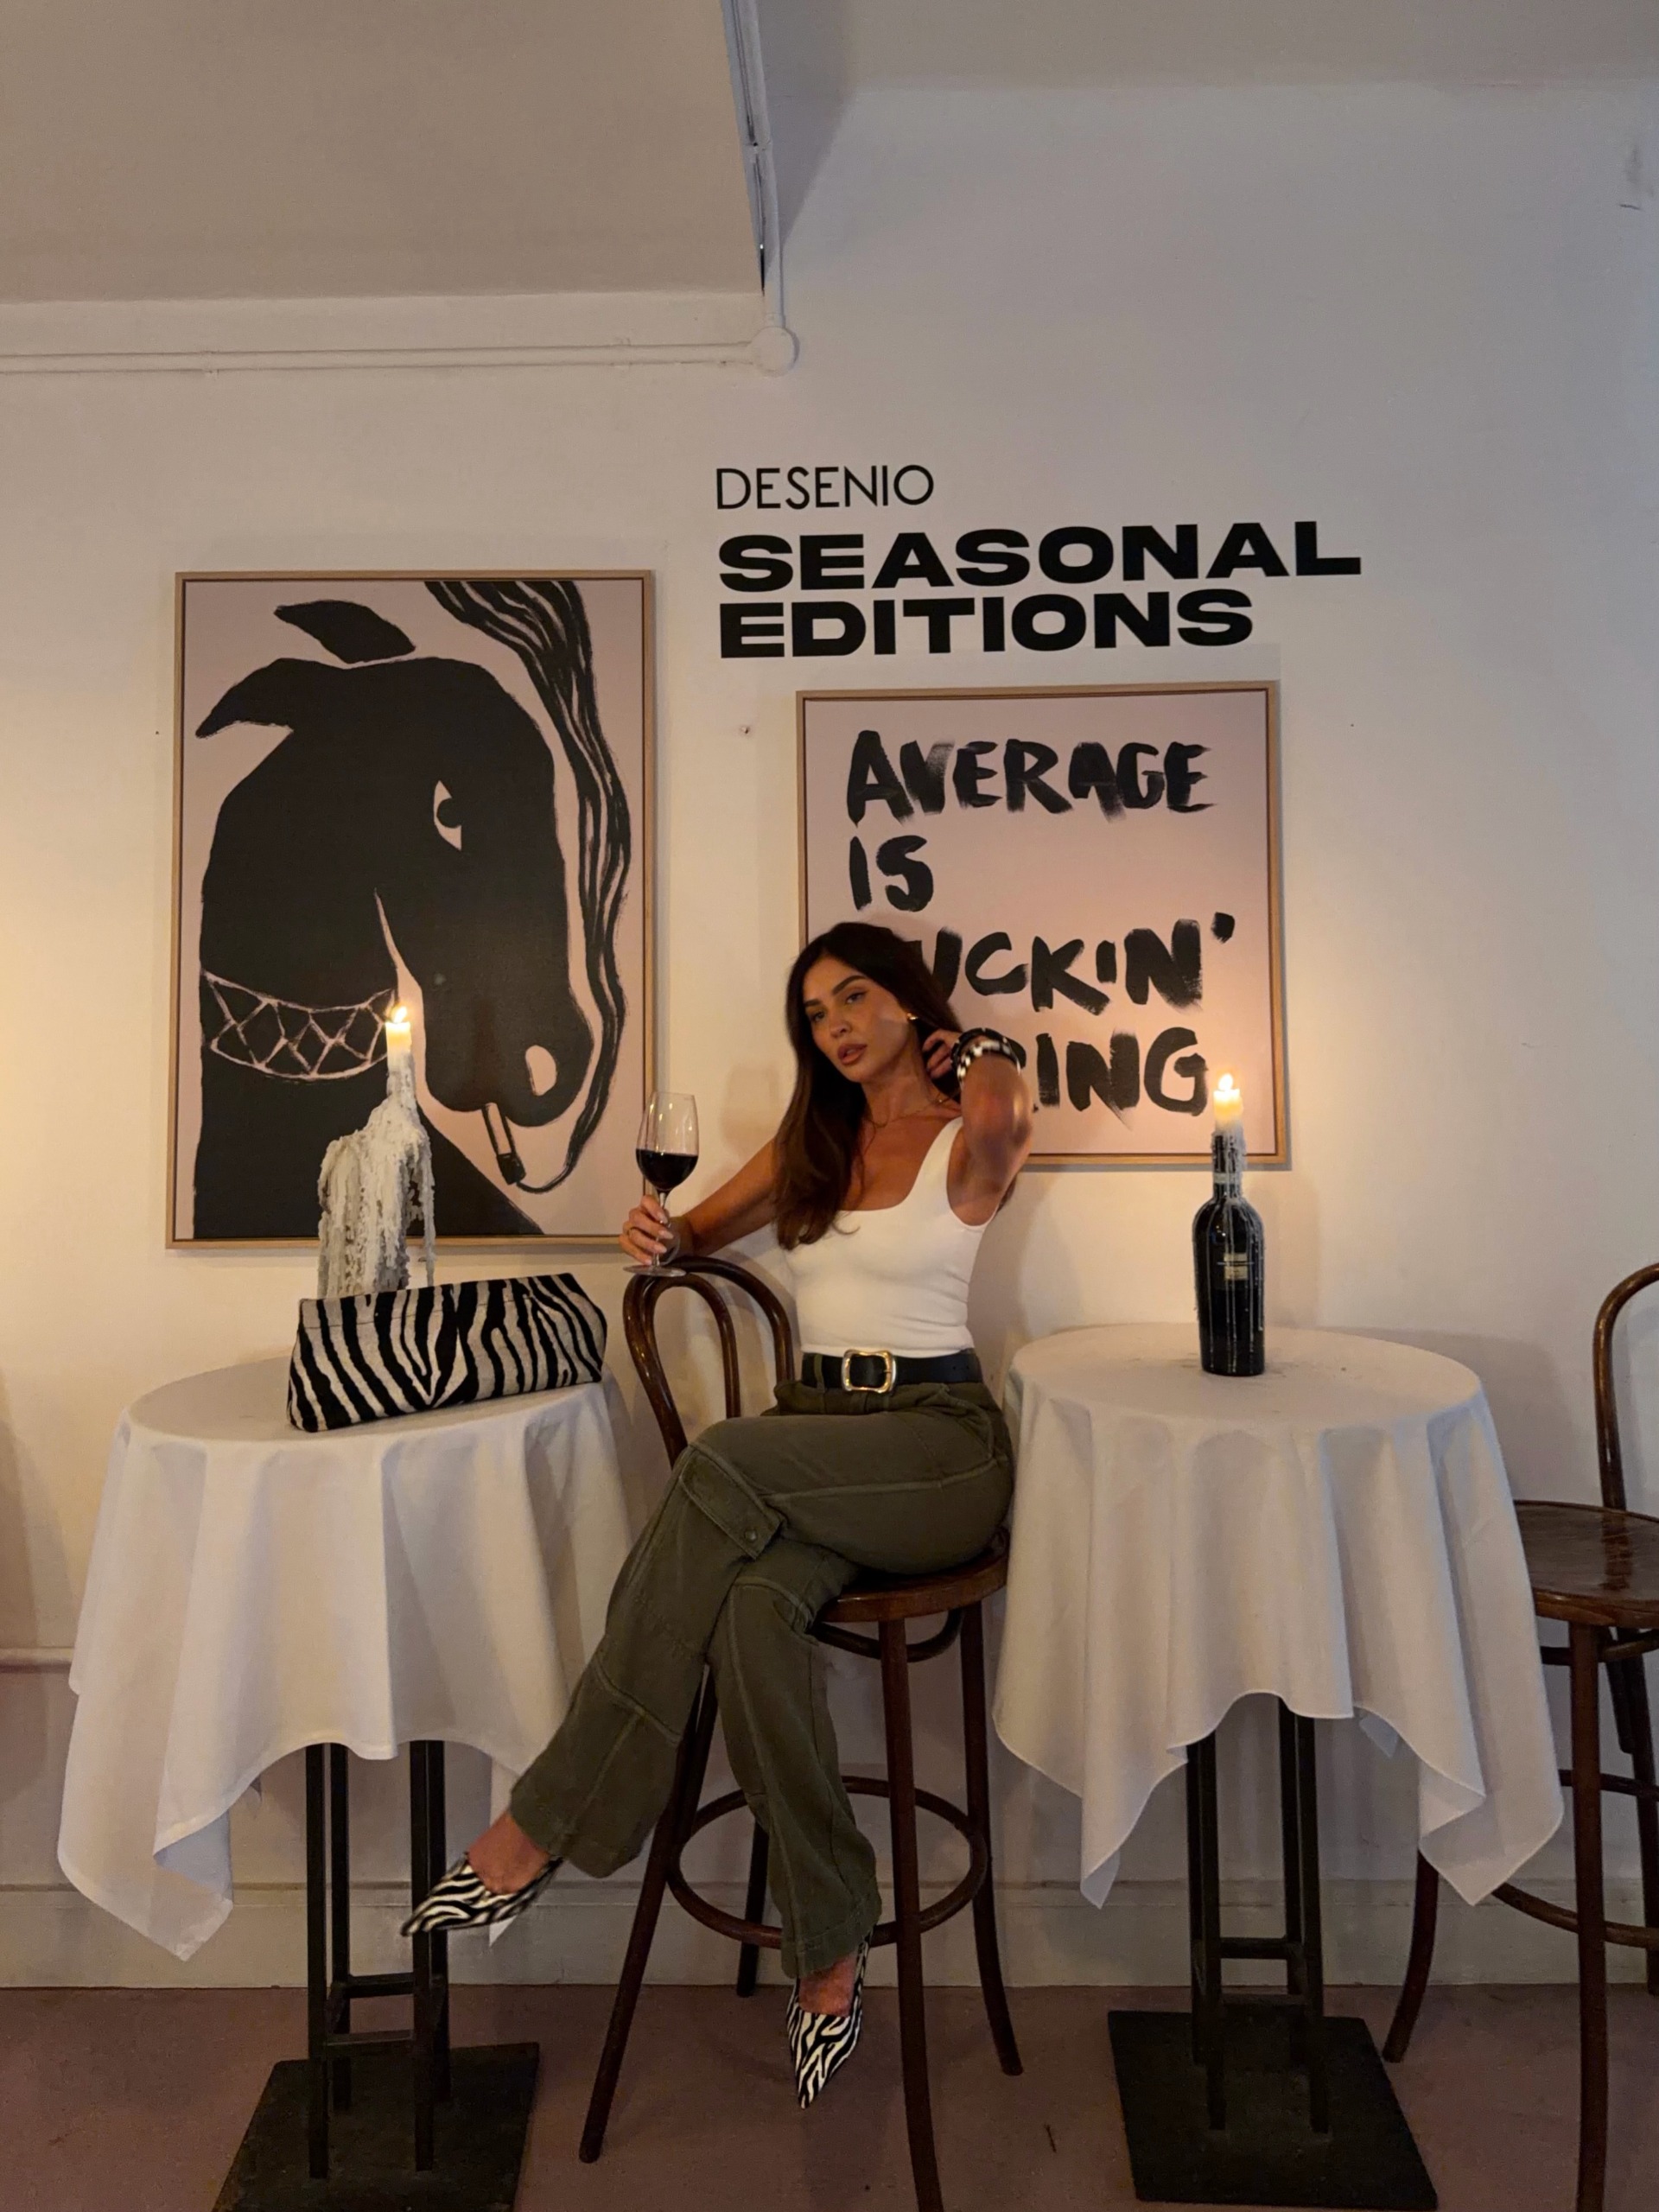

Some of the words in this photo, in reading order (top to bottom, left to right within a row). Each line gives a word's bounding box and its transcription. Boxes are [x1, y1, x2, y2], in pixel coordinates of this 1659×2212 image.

[716, 464, 934, 510] DESENIO
[718, 520, 1362, 593] SEASONAL
[719, 588, 1253, 658] EDITIONS
[846, 729, 1216, 828] AVERAGE
[849, 835, 934, 912] IS
[906, 912, 1236, 1016] UCKIN'
[1013, 1027, 1208, 1128] ING
